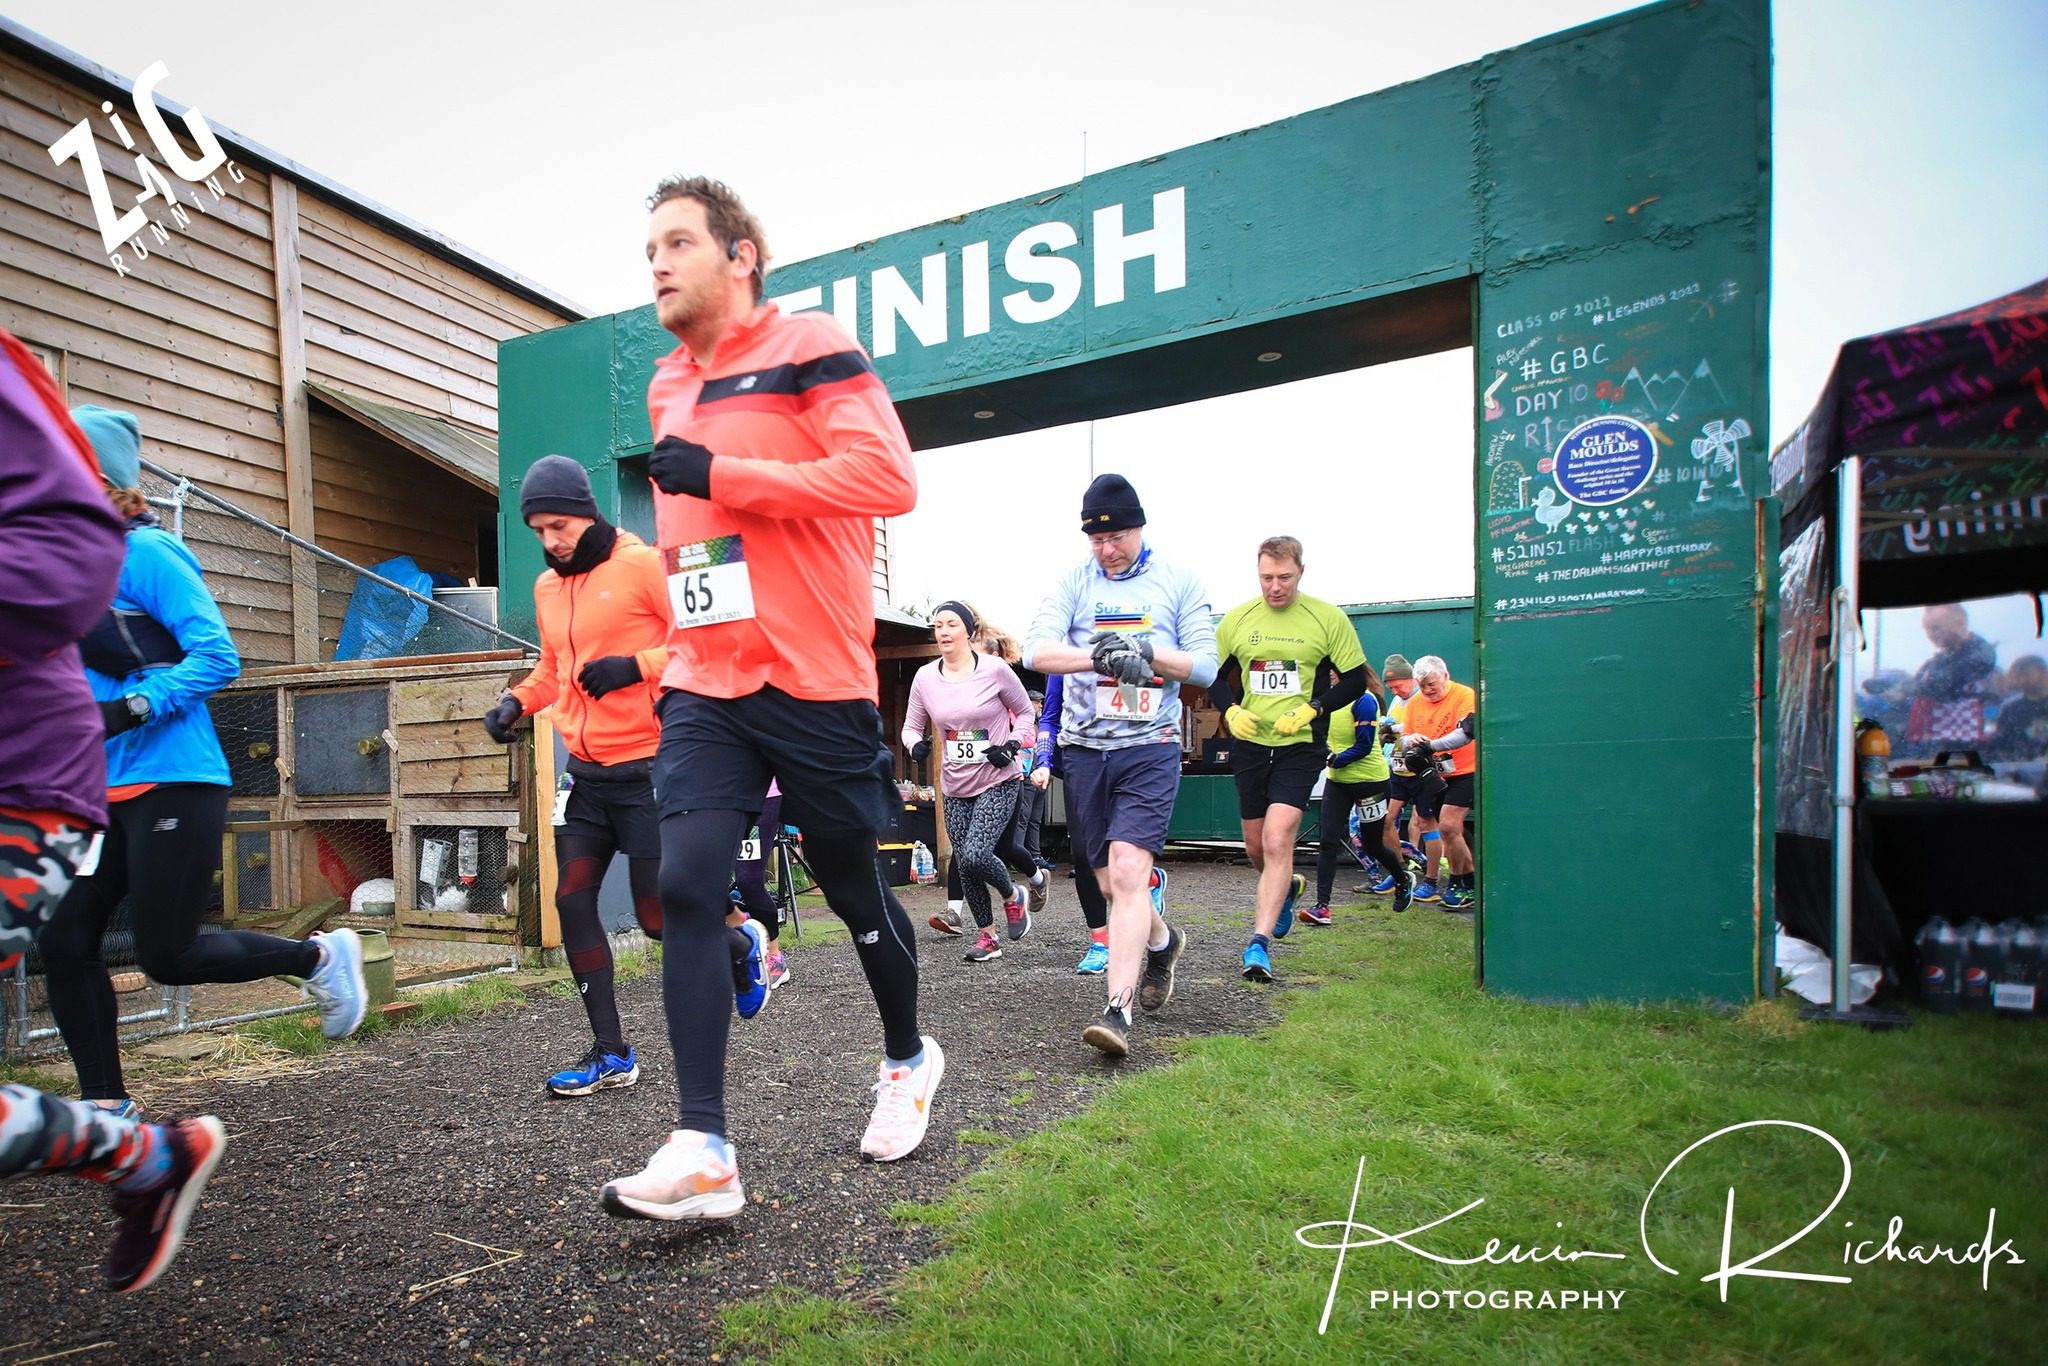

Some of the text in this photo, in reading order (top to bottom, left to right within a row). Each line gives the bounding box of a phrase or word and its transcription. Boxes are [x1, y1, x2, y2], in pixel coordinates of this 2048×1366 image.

[1496, 296, 1612, 338] CLASS OF 2022
[1516, 388, 1563, 416] DAY
[1569, 383, 1588, 404] 10
[1581, 431, 1627, 448] GLEN
[1569, 439, 1640, 460] MOULDS
[684, 572, 713, 614] 65
[1095, 602, 1152, 615] Suzu
[1261, 672, 1288, 690] 104
[1111, 689, 1151, 714] 48
[957, 742, 974, 759] 58
[1360, 803, 1381, 816] 121
